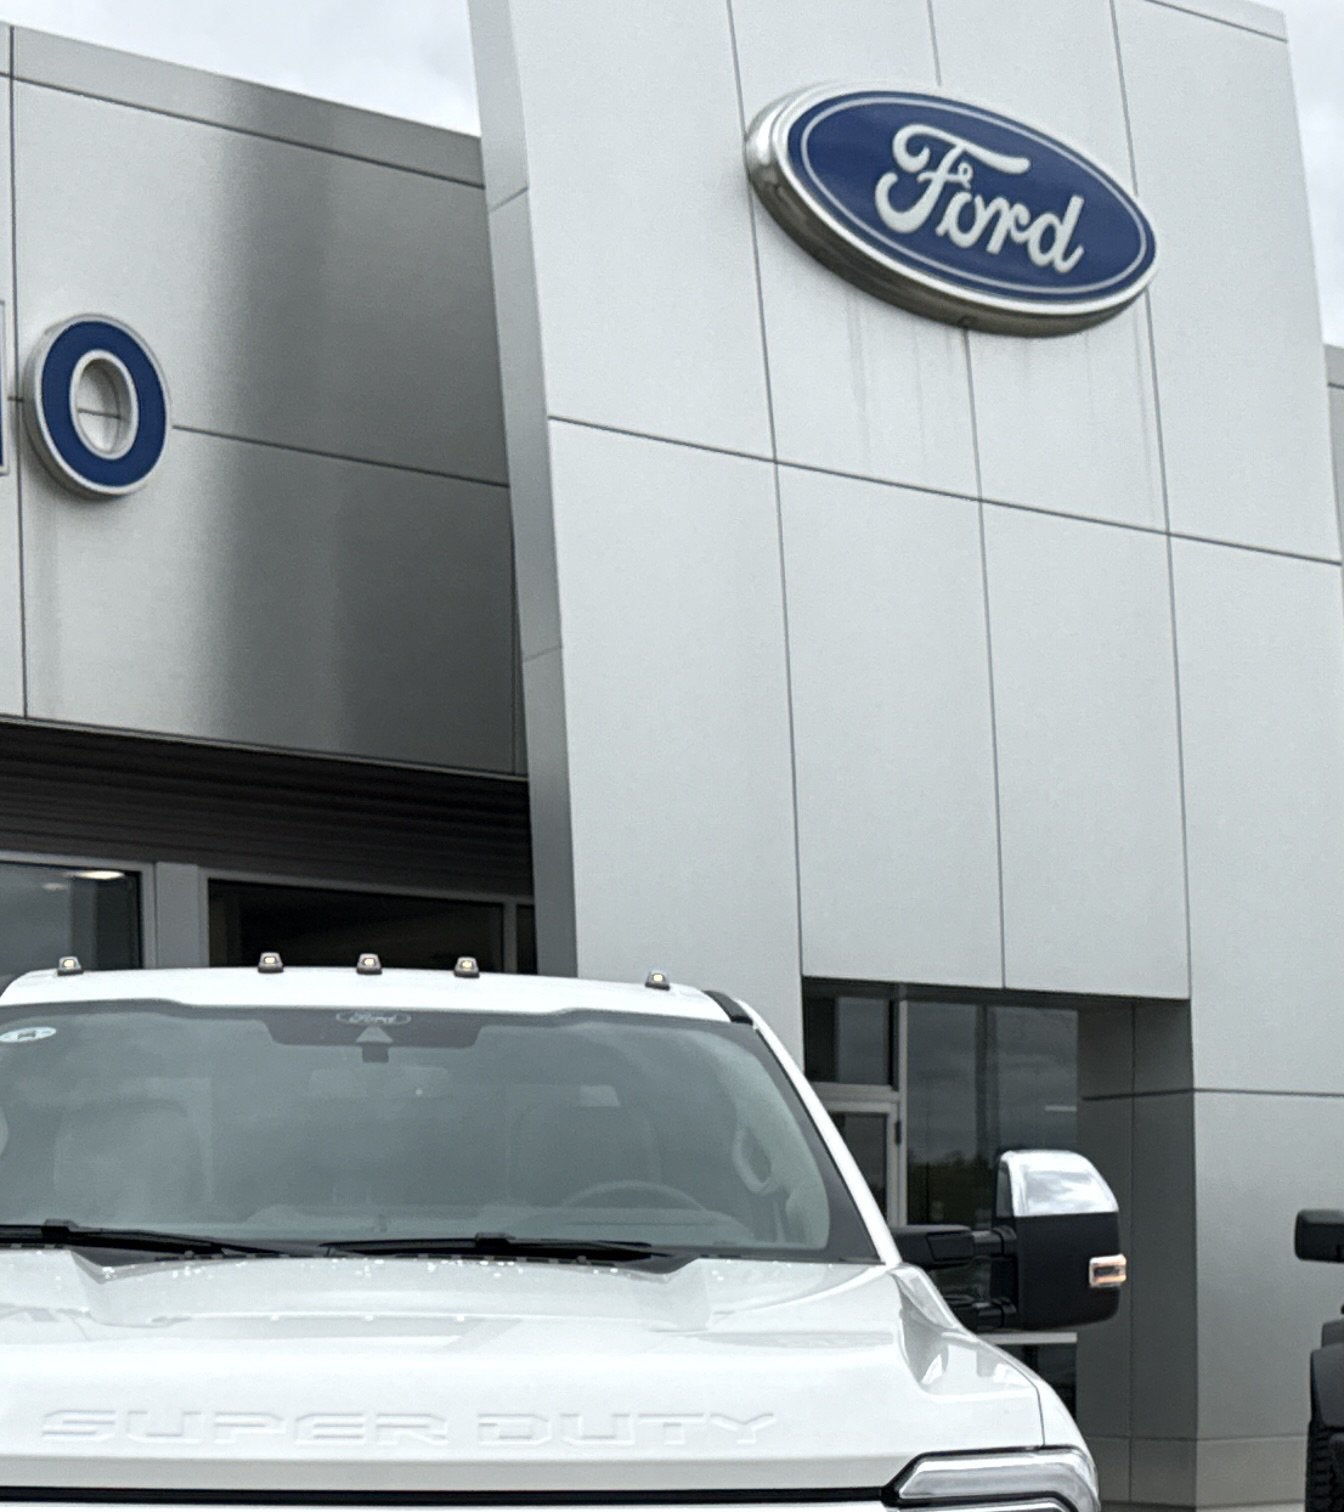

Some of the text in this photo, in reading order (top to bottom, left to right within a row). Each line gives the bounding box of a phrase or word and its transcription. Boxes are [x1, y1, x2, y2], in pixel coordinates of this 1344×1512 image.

[875, 123, 1085, 273] Ford
[42, 1410, 777, 1446] SUPER DUTY
